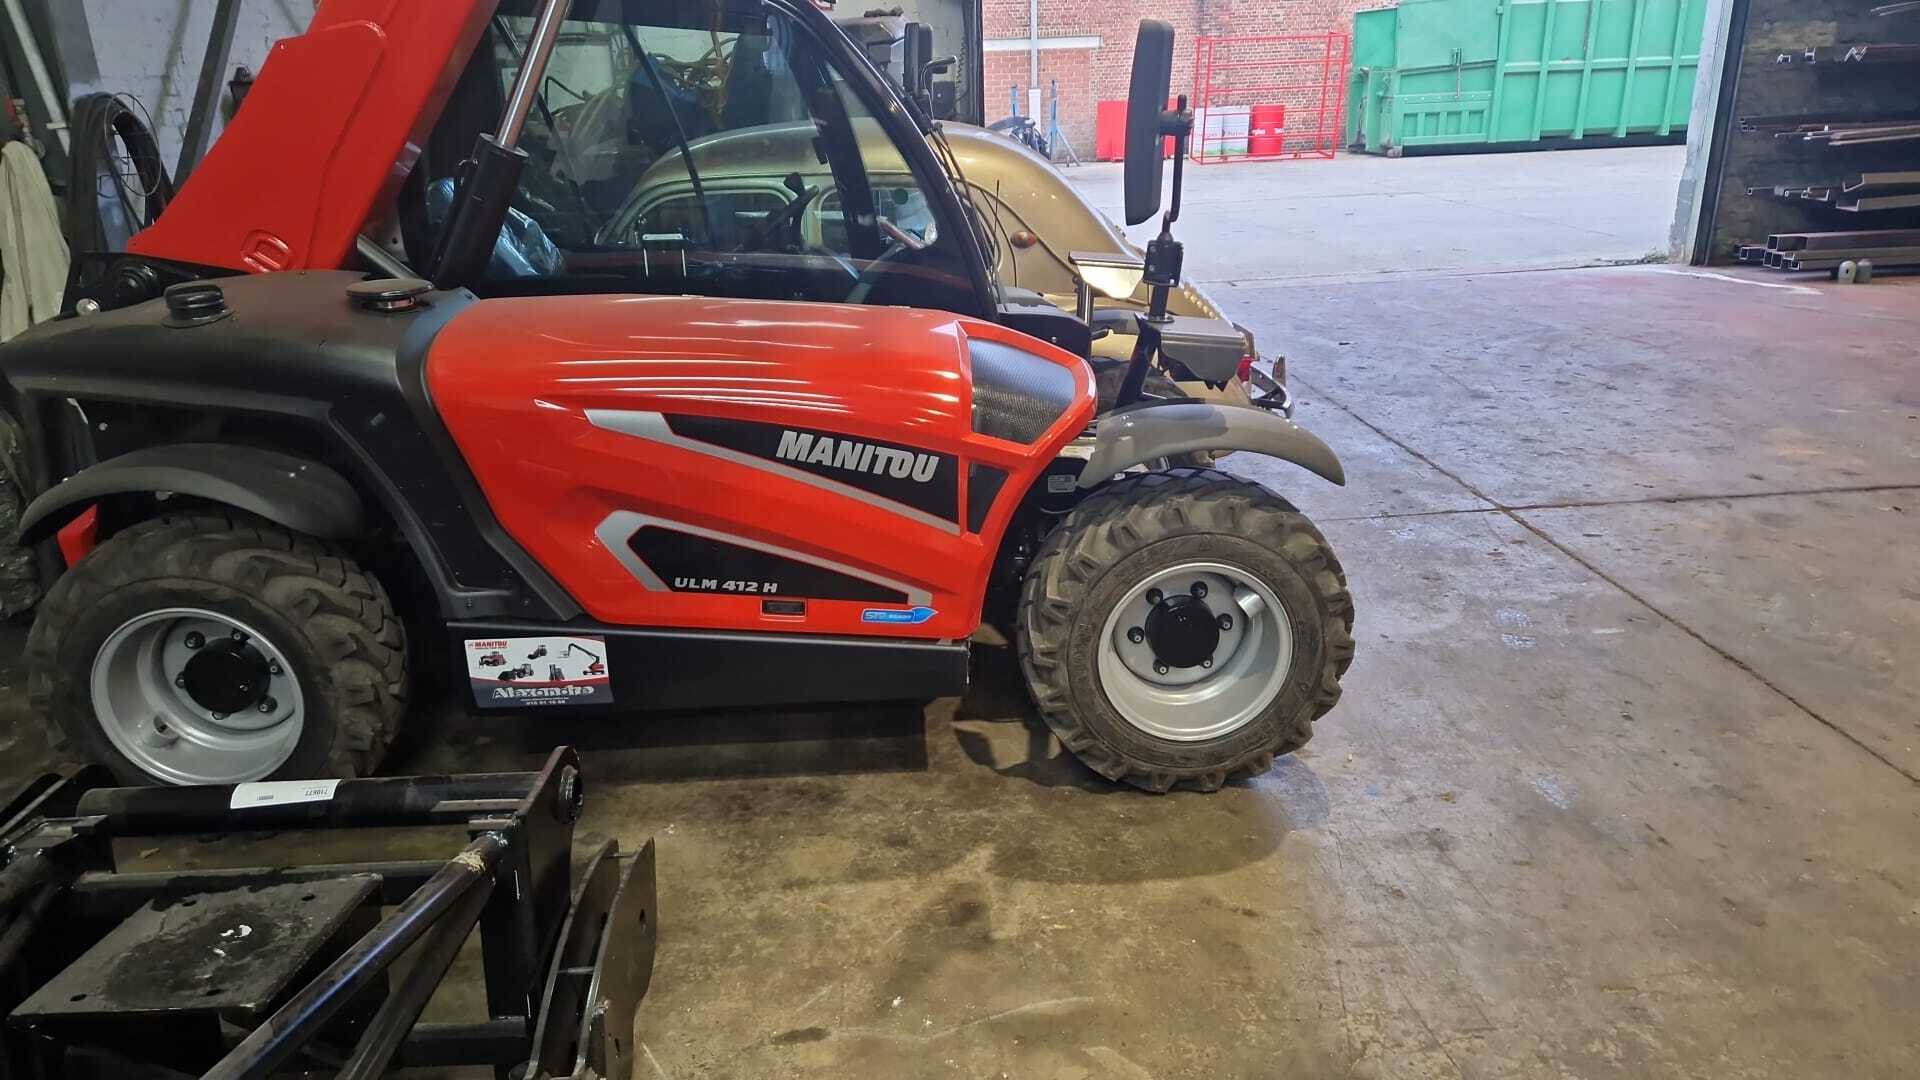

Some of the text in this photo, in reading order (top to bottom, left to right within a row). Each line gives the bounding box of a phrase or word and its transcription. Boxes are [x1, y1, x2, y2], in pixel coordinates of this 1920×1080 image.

[775, 430, 940, 483] MANITOU
[674, 577, 778, 593] ULM 412 H
